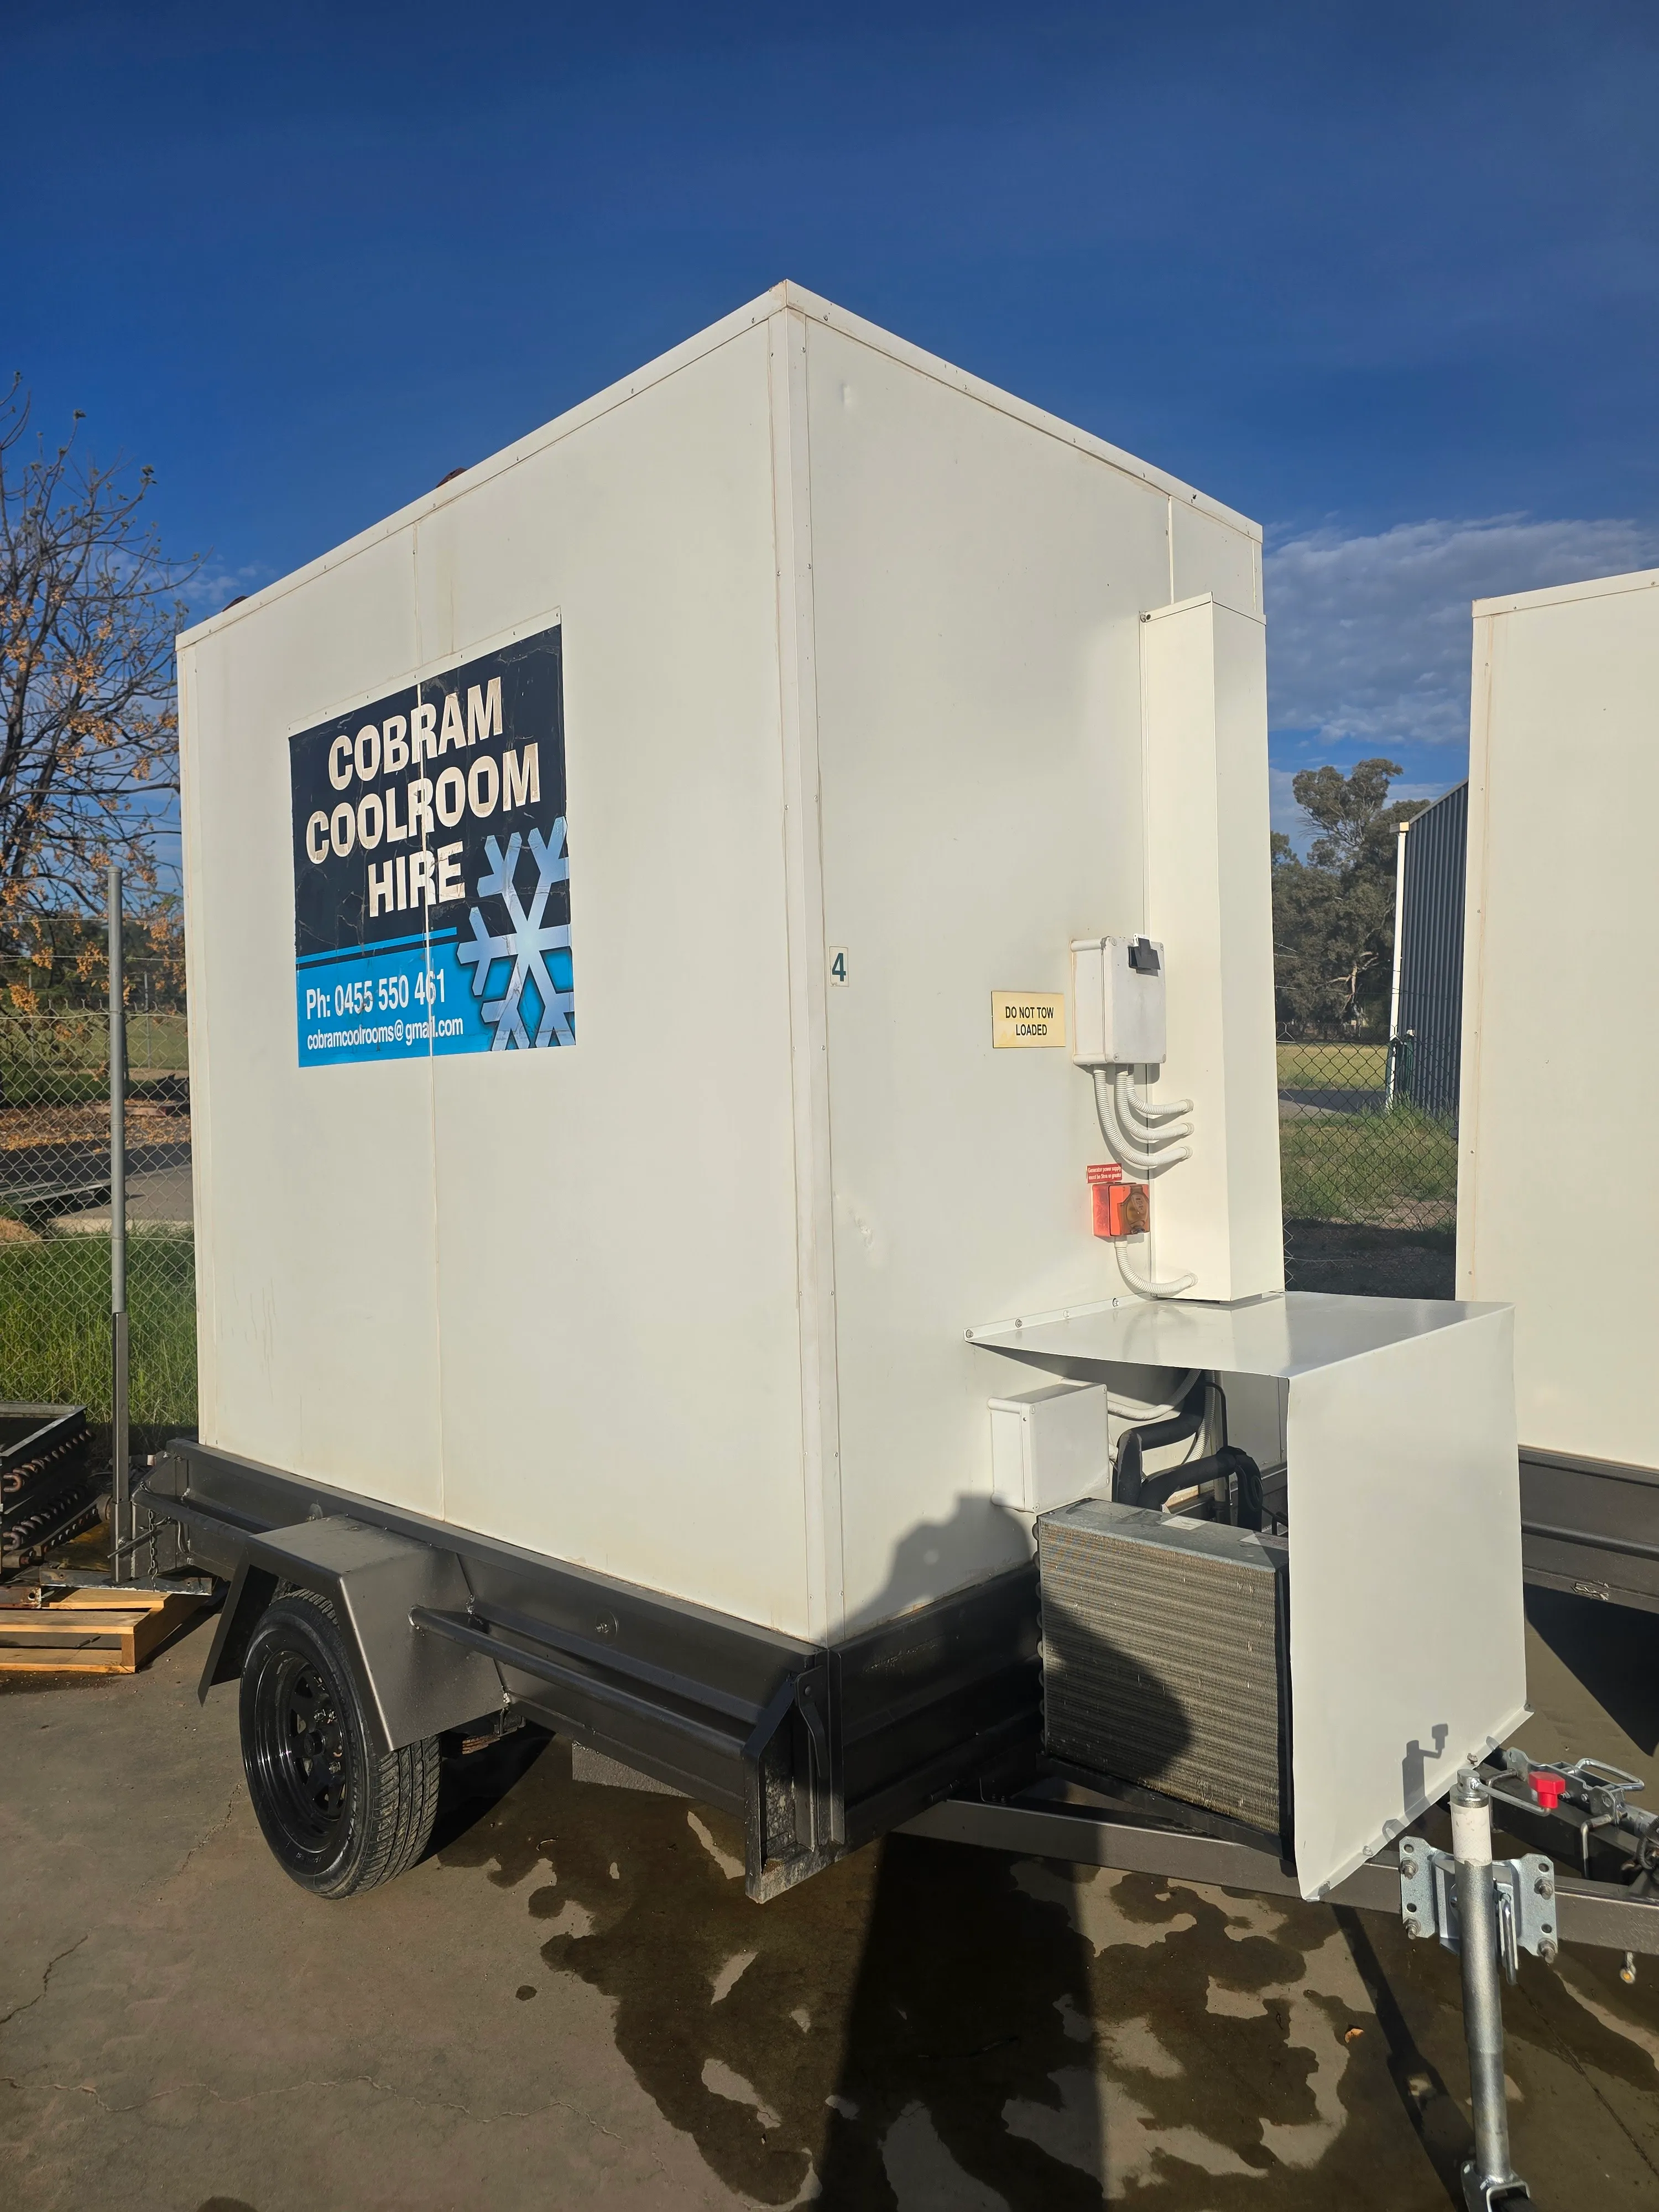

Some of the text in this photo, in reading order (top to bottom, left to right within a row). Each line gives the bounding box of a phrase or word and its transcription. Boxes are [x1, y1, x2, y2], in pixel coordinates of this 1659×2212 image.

[328, 677, 503, 790] COBRAM
[306, 743, 540, 864] COOLROOM
[368, 841, 465, 917] HIRE
[832, 953, 846, 982] 4
[306, 968, 445, 1019] Ph: 0455 550 461
[1005, 1006, 1053, 1019] DO NOT TOW
[1016, 1024, 1047, 1036] LOADED
